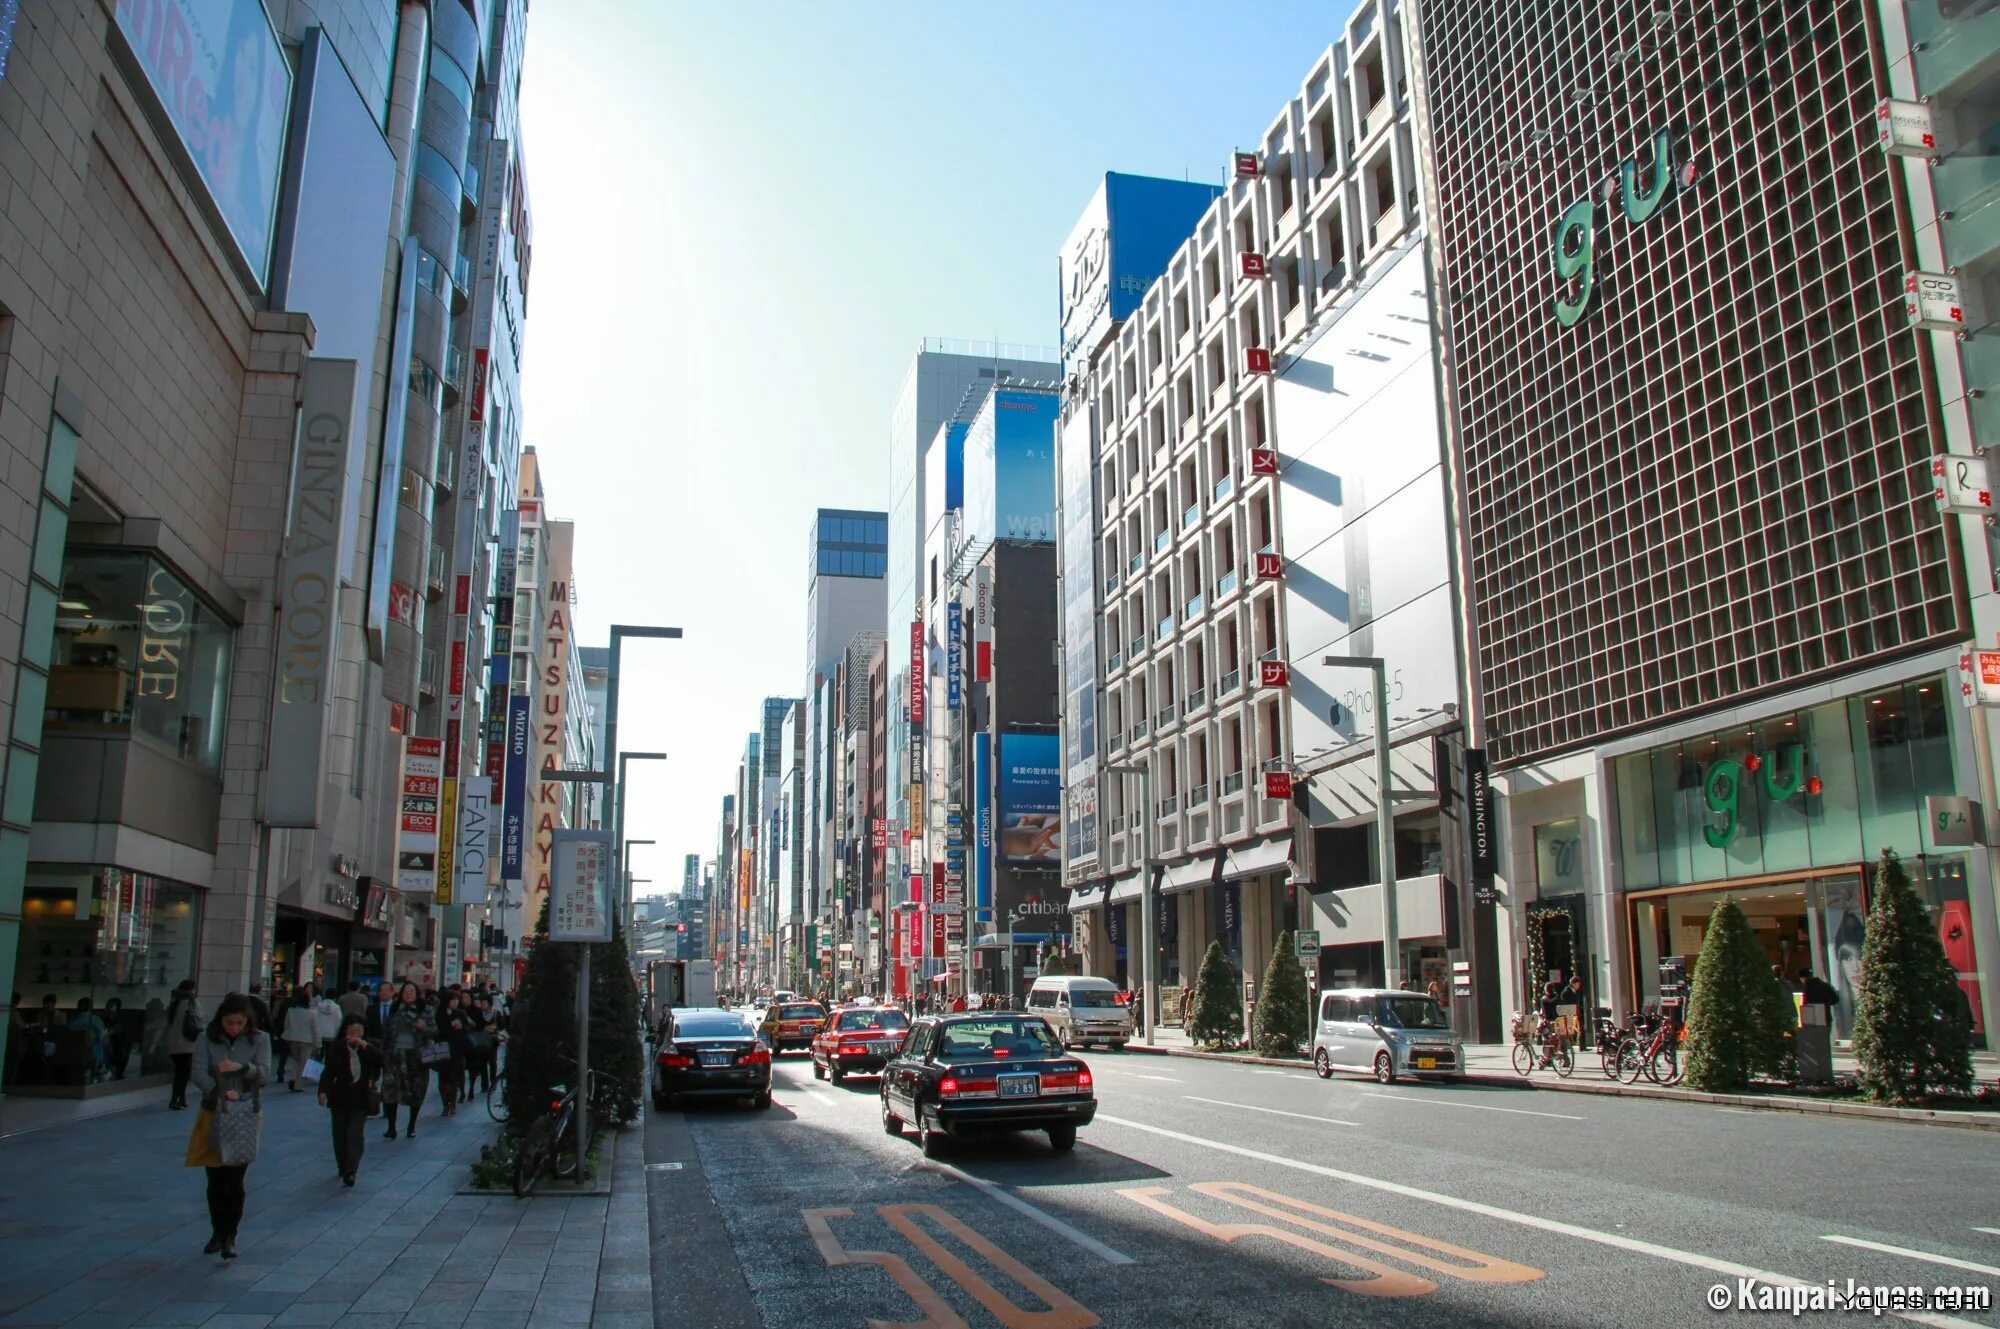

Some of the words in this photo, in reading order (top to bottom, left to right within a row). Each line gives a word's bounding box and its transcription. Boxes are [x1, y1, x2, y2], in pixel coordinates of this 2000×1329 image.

[294, 412, 344, 558] GINZA
[979, 582, 988, 625] docomo
[280, 572, 329, 704] CORE
[912, 665, 921, 715] NATARAJ
[1343, 683, 1391, 721] iPhoe
[514, 709, 526, 755] MIZUHO
[536, 580, 567, 892] MATSUZAKAYA
[409, 816, 433, 825] ECC
[1474, 771, 1487, 858] WASHINGTON
[1703, 744, 1823, 848] g.u.
[462, 795, 487, 885] FANCL
[507, 815, 519, 865] みずほ銀行
[980, 806, 990, 847] citibank
[935, 883, 943, 938] DALYAU
[1018, 900, 1070, 915] citiban
